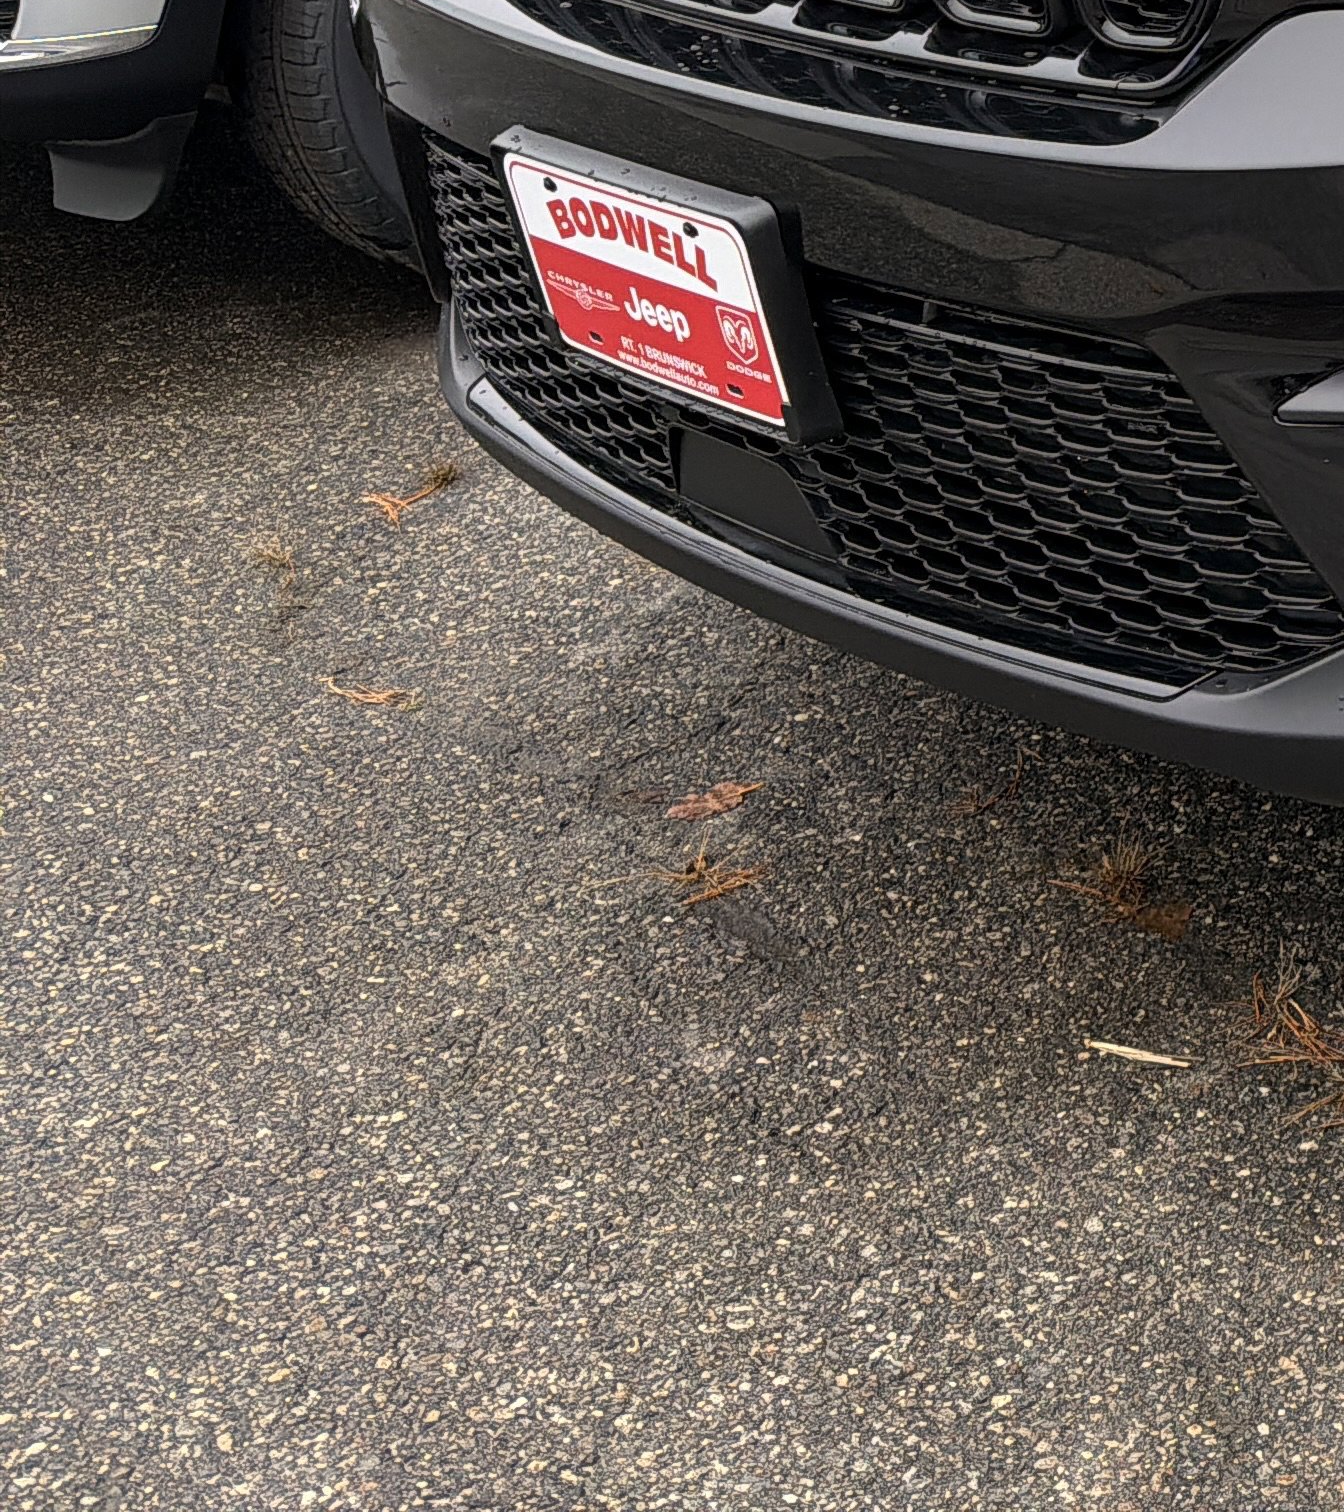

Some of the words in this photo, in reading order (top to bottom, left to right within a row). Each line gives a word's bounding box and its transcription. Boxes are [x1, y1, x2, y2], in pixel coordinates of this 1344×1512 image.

[546, 197, 718, 292] BODWELL
[547, 270, 613, 302] CHRYSLER
[624, 287, 690, 342] Jeep
[617, 349, 720, 396] www.bodwellauto.com
[621, 336, 637, 353] RT.
[645, 344, 707, 379] BRUNSWICK
[726, 360, 772, 383] DODGE
